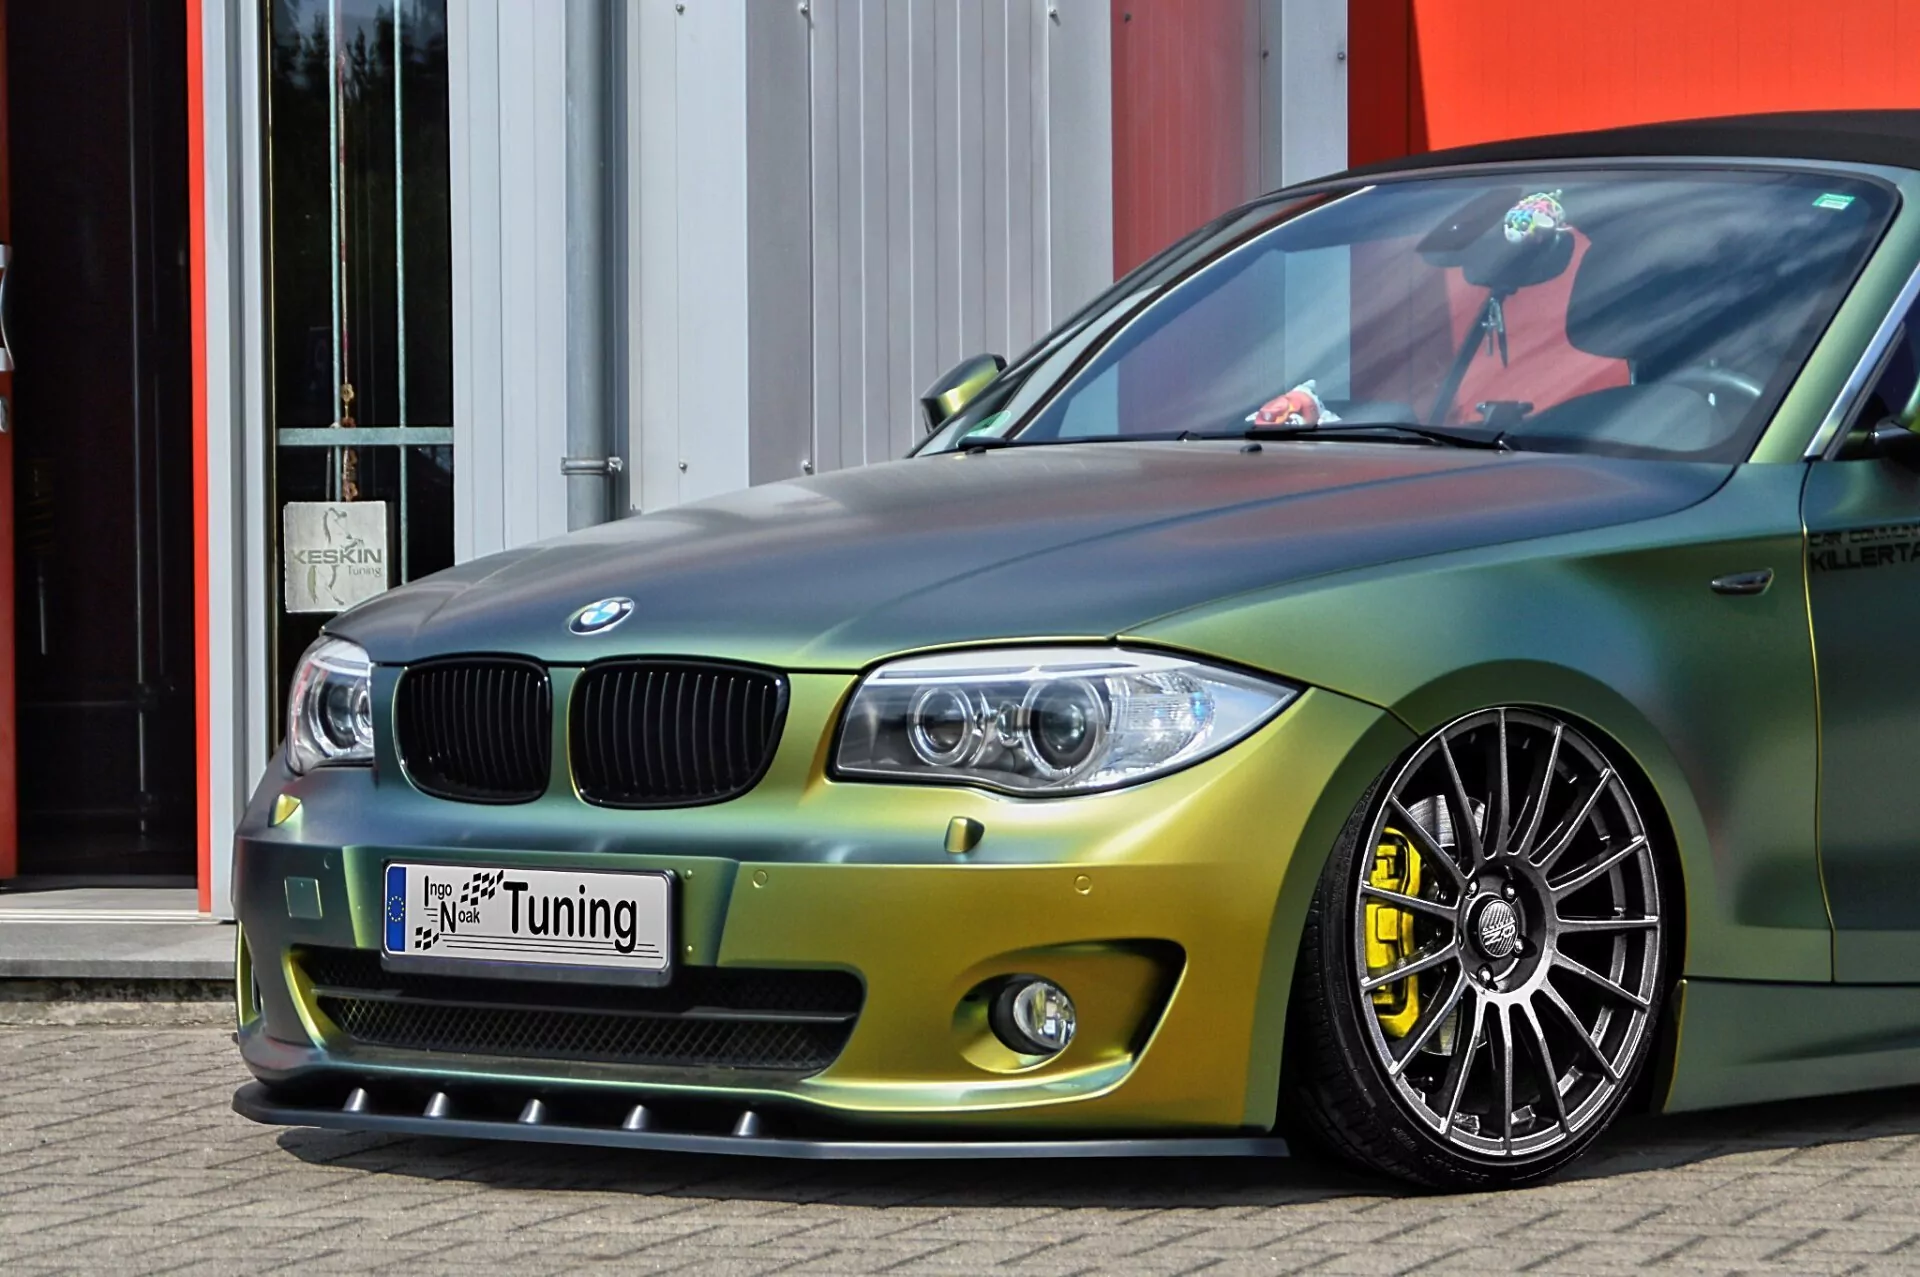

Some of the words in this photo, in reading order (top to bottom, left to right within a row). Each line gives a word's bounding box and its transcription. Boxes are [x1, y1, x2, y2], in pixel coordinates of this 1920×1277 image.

[290, 548, 383, 565] KESKIN
[347, 565, 382, 578] Tuning
[424, 875, 453, 907] Ingo
[440, 901, 481, 934] Noak
[502, 881, 637, 954] Tuning
